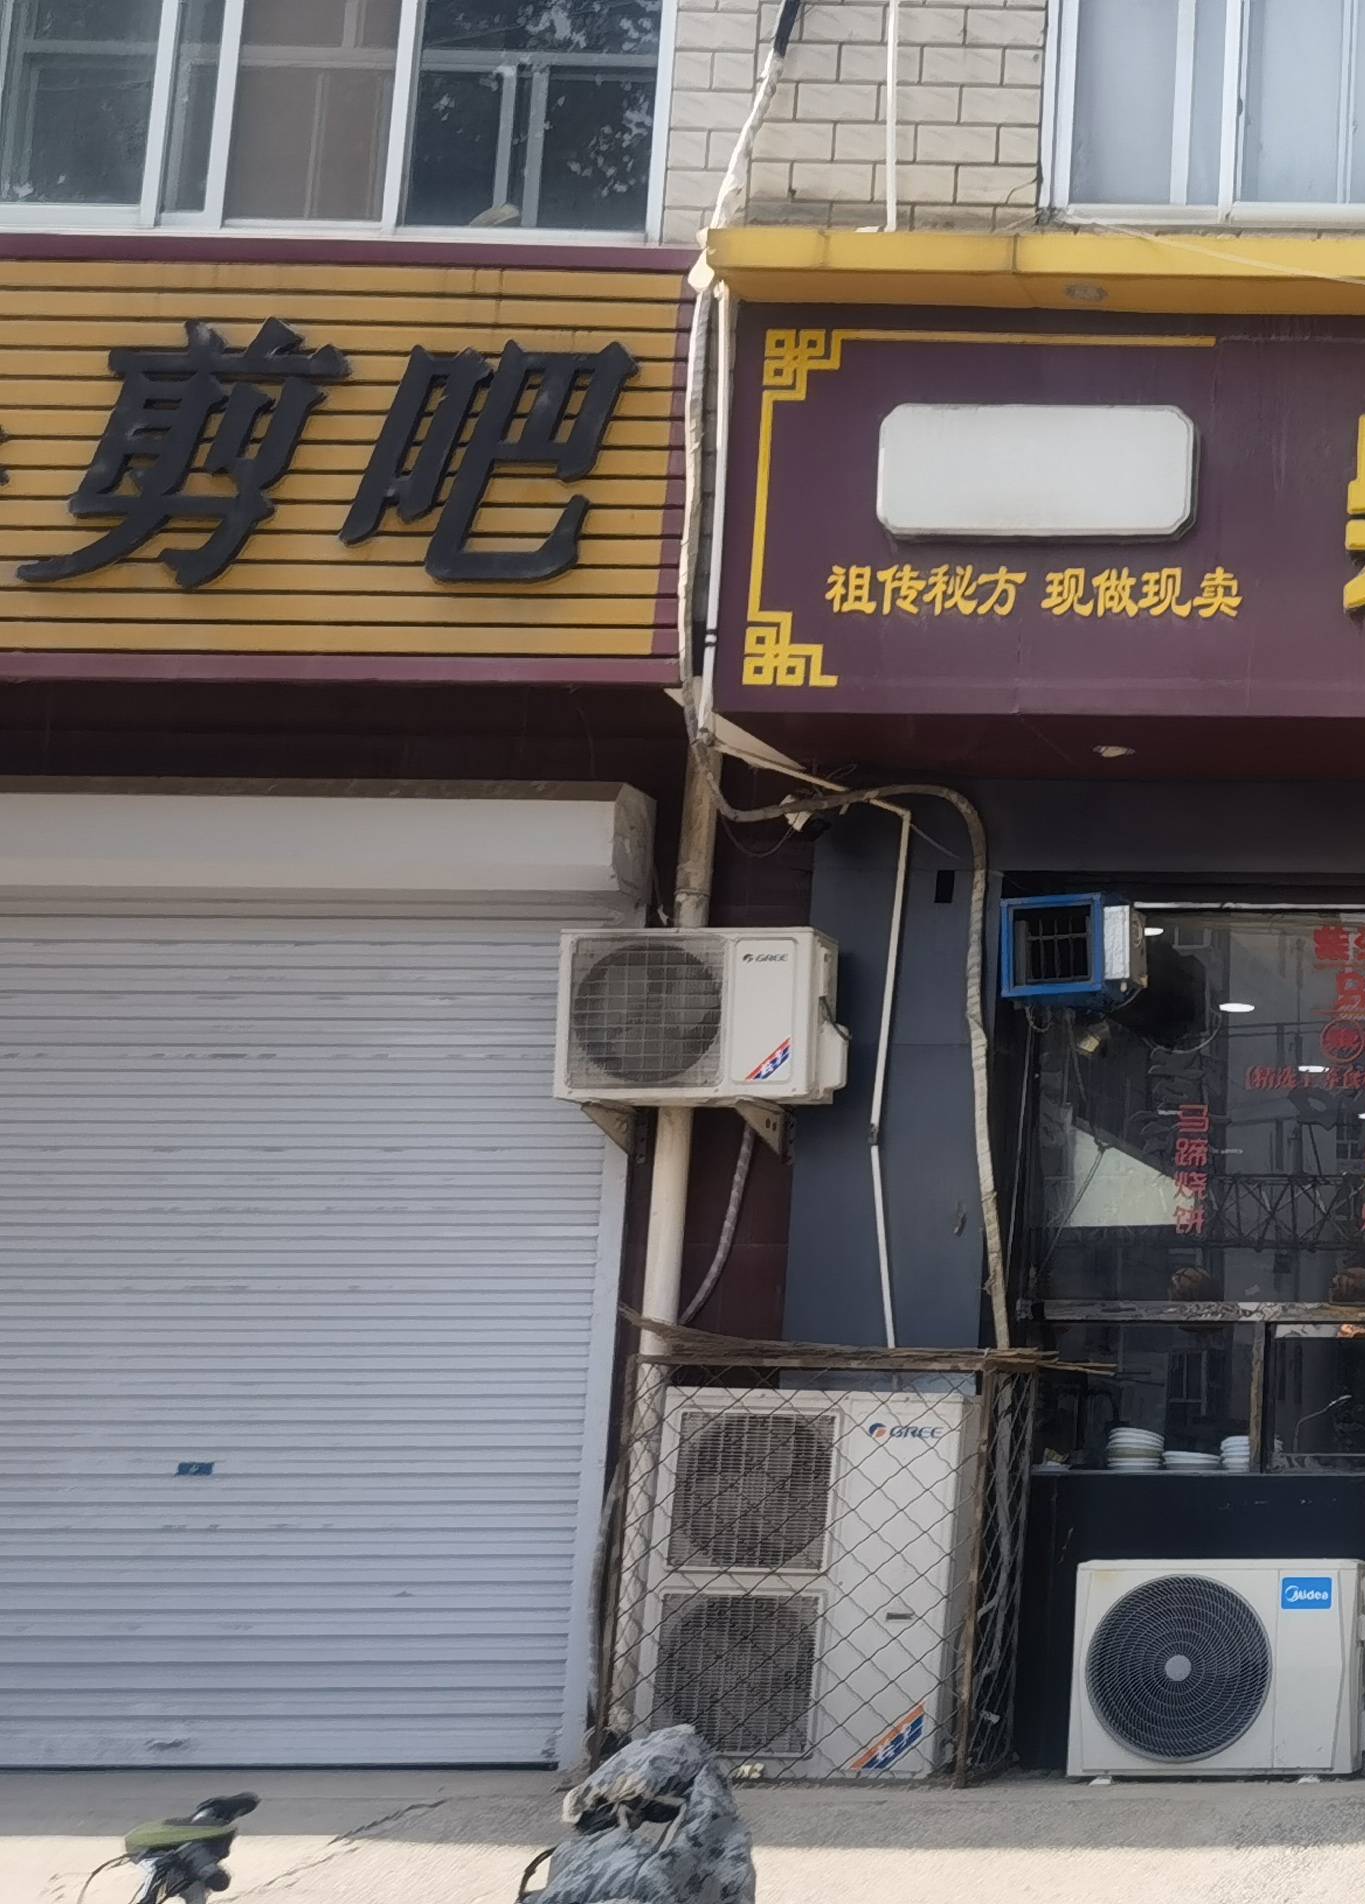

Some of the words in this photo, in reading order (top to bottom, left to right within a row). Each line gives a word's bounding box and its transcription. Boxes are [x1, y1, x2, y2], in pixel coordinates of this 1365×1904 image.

[0, 317, 640, 589] 剪吧
[825, 565, 1027, 615] 祖传秘方
[1041, 567, 1243, 618] 现做现卖
[1173, 1105, 1209, 1235] 马蹄烧饼
[890, 1425, 942, 1439] GREE
[1285, 1585, 1328, 1602] Midea
